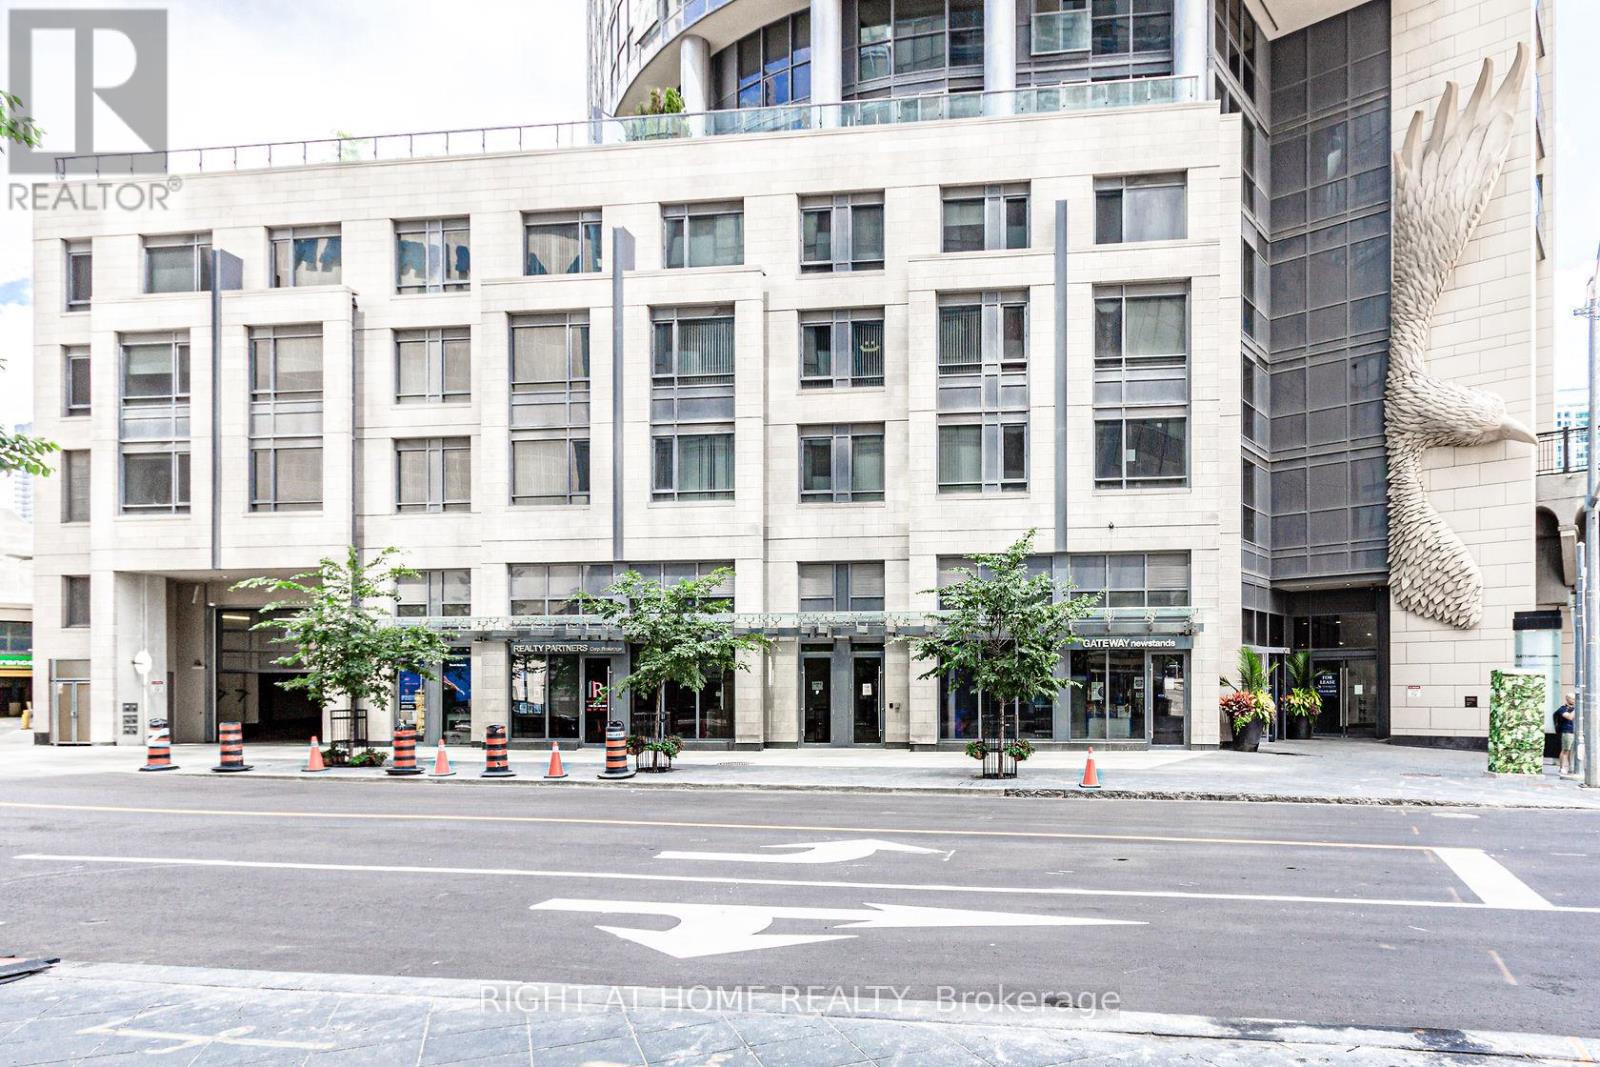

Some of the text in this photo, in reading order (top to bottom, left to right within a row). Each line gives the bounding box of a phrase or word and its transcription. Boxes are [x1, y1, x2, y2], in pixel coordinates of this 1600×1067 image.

[1083, 639, 1176, 648] GATEWAY newstands
[513, 644, 544, 652] REALTY
[545, 644, 588, 652] PARTNERS
